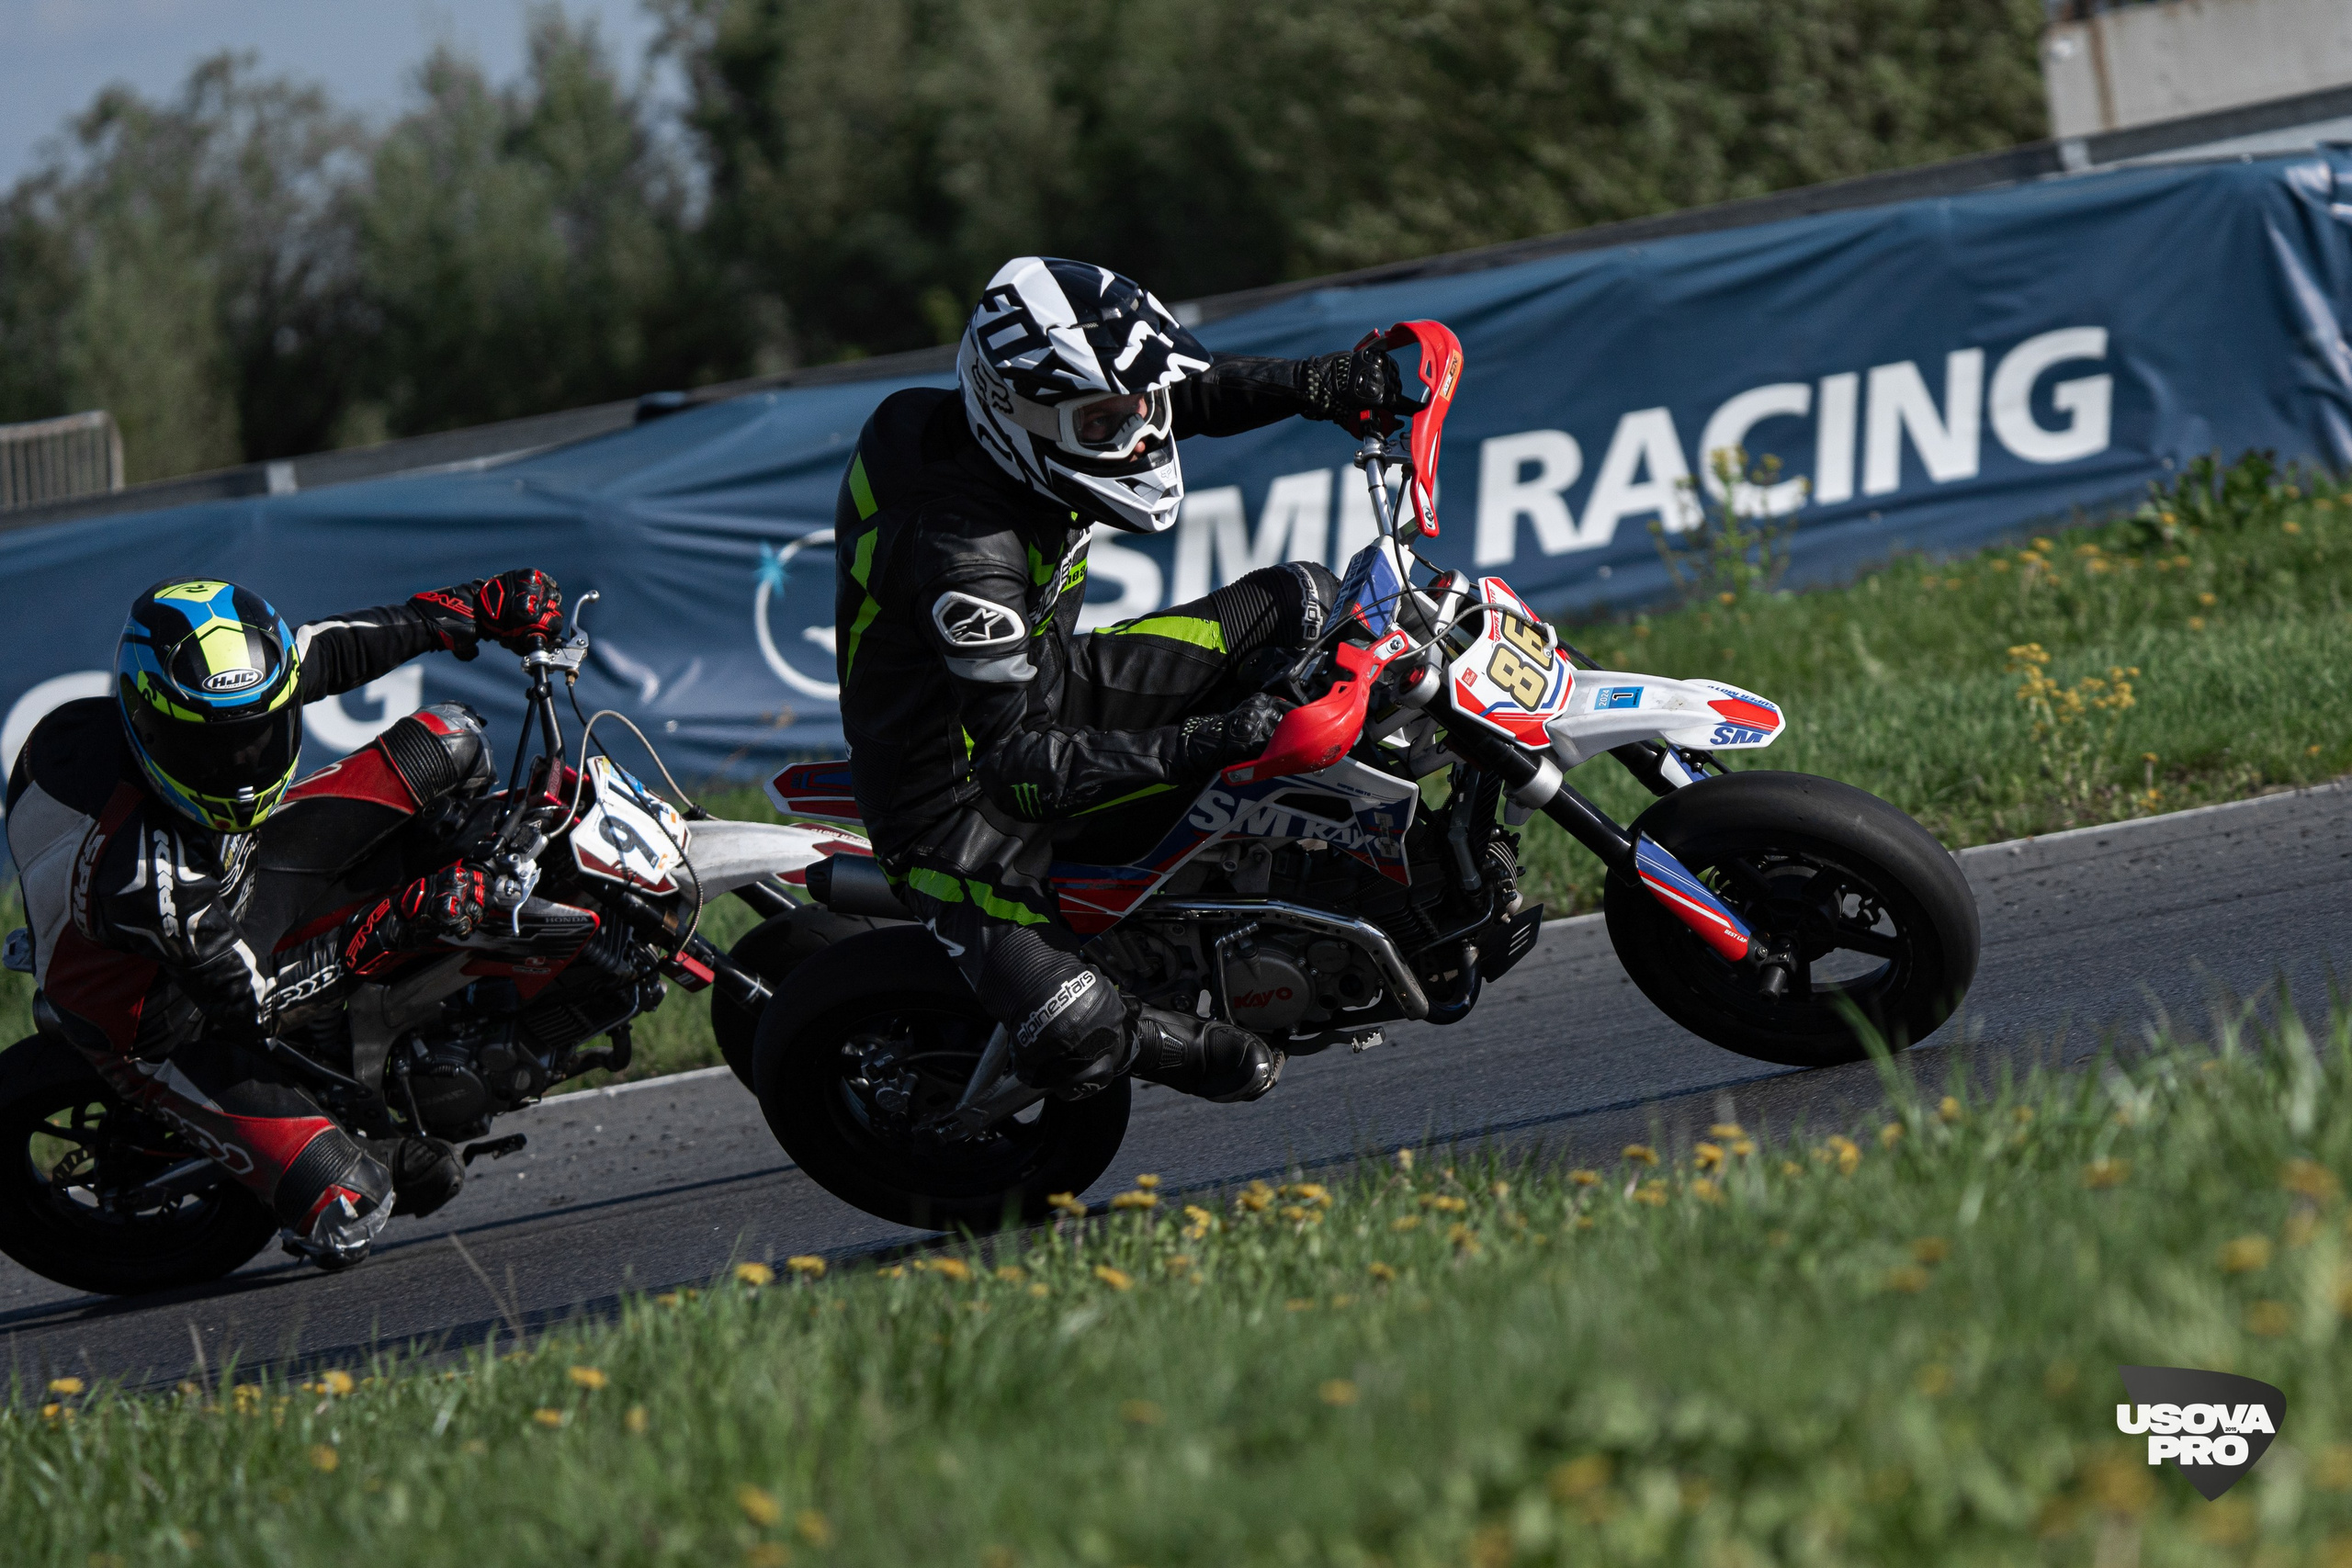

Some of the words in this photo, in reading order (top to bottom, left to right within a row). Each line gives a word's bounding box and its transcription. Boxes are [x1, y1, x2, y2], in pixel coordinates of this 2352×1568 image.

[1476, 324, 2113, 570] RACING
[1487, 611, 1555, 713] 86
[211, 671, 254, 688] HJC
[1599, 689, 1611, 706] 2024
[1612, 693, 1634, 701] 1
[1710, 726, 1764, 745] SM
[1188, 789, 1293, 837] SM
[544, 914, 589, 925] HONDA
[345, 897, 390, 970] FIVE
[1724, 929, 1738, 939] BEST
[1736, 933, 1747, 943] LAP
[1017, 970, 1095, 1045] alpinestars
[1233, 987, 1293, 1009] KAYO
